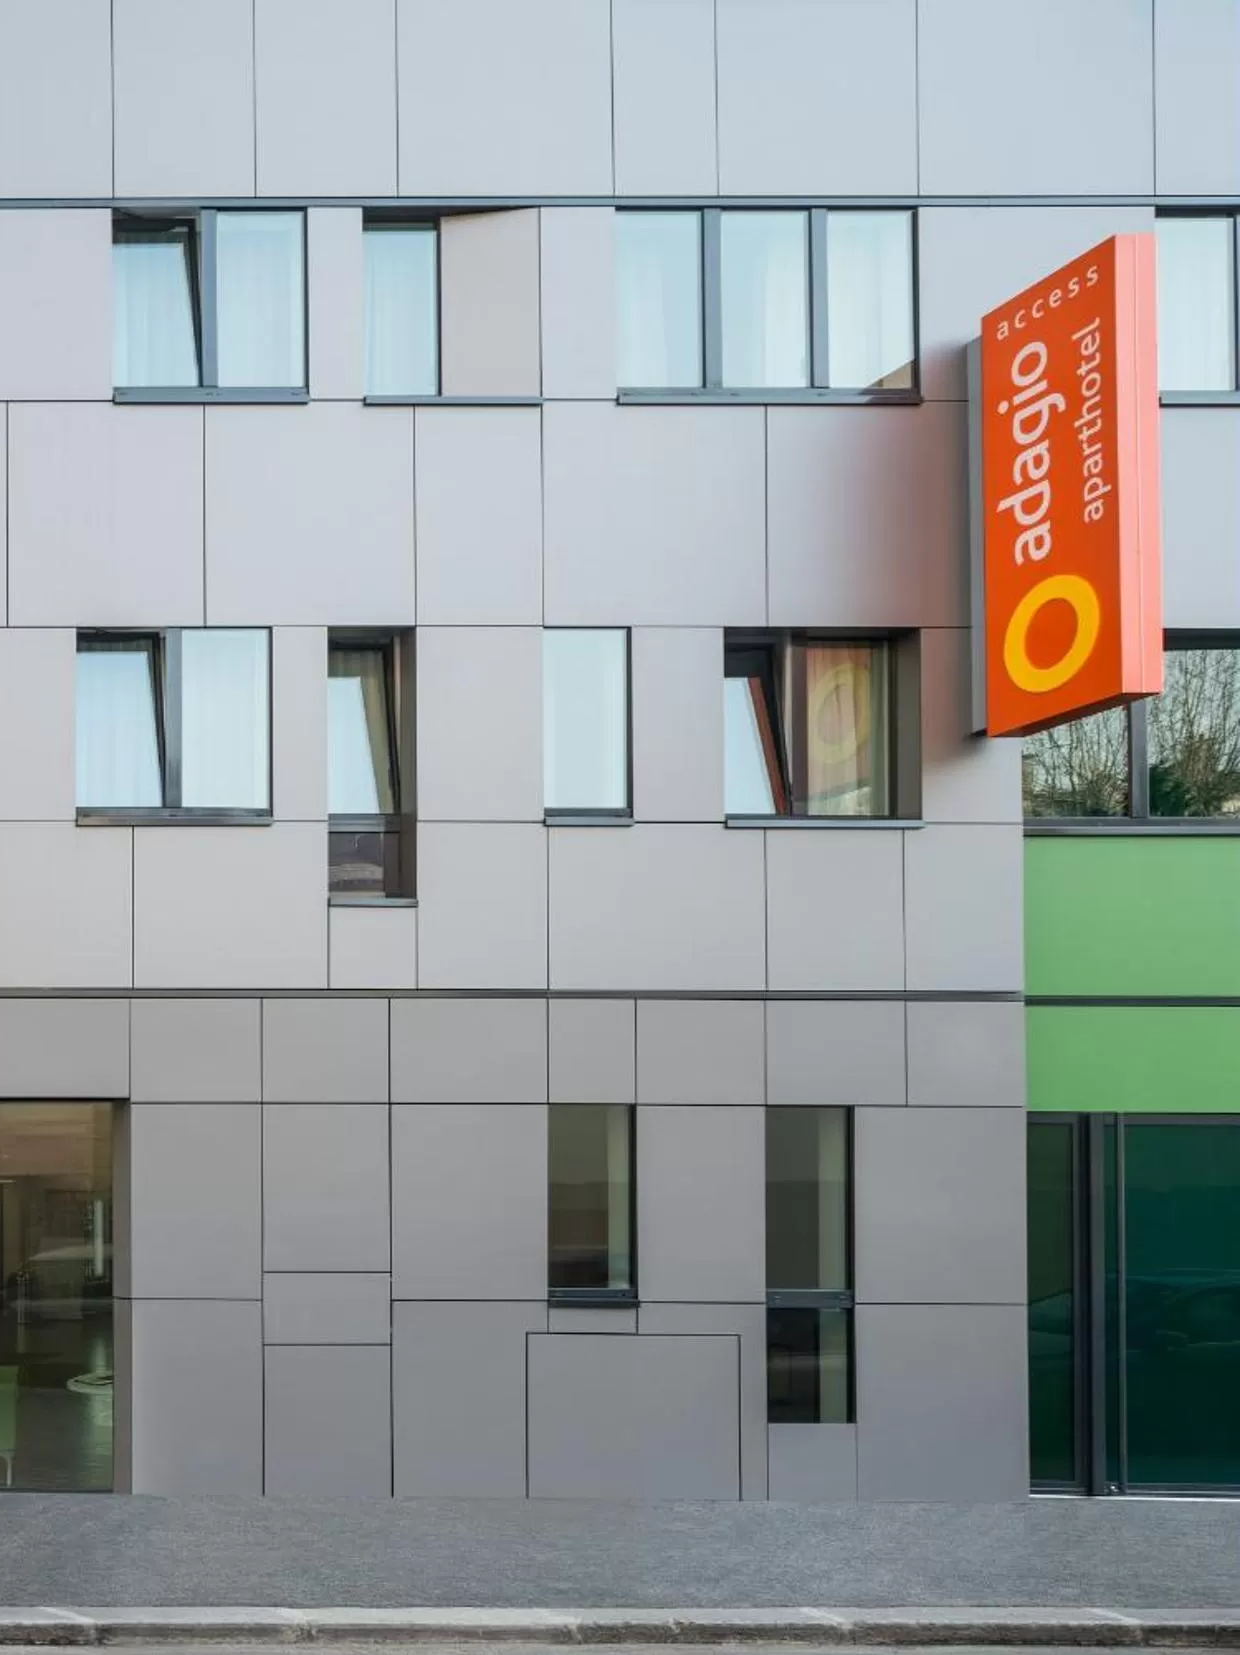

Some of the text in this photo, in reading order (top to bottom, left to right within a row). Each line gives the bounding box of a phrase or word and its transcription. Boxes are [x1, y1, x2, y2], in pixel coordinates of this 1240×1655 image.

[995, 263, 1099, 341] access
[996, 340, 1065, 566] adagio
[1072, 316, 1110, 524] aparthotel
